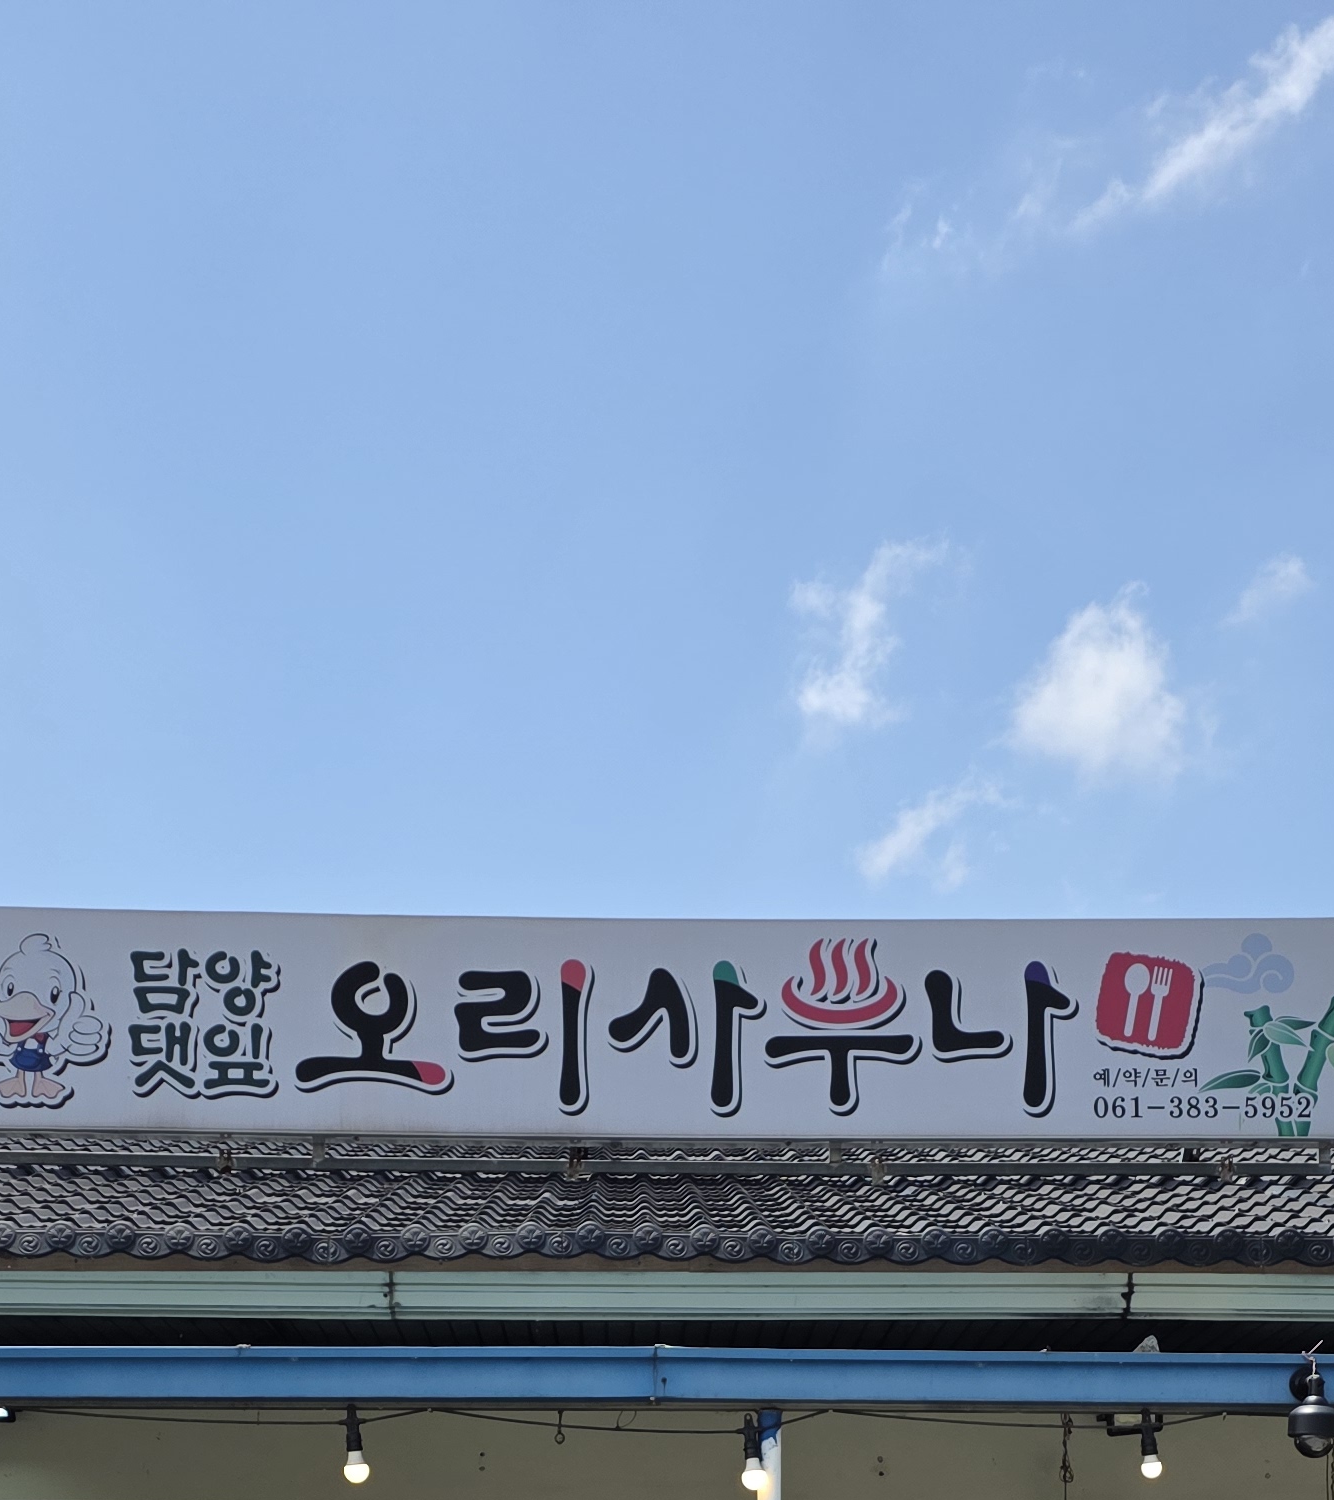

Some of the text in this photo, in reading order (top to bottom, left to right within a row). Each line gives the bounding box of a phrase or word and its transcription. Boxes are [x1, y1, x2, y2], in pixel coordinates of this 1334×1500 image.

[129, 948, 273, 1017] 담양
[127, 1020, 272, 1090] 댓잎
[295, 938, 1071, 1113] 오리사우나
[1092, 1067, 1199, 1088] 예/약/문/의
[1092, 1095, 1312, 1119] 061-383-5952
